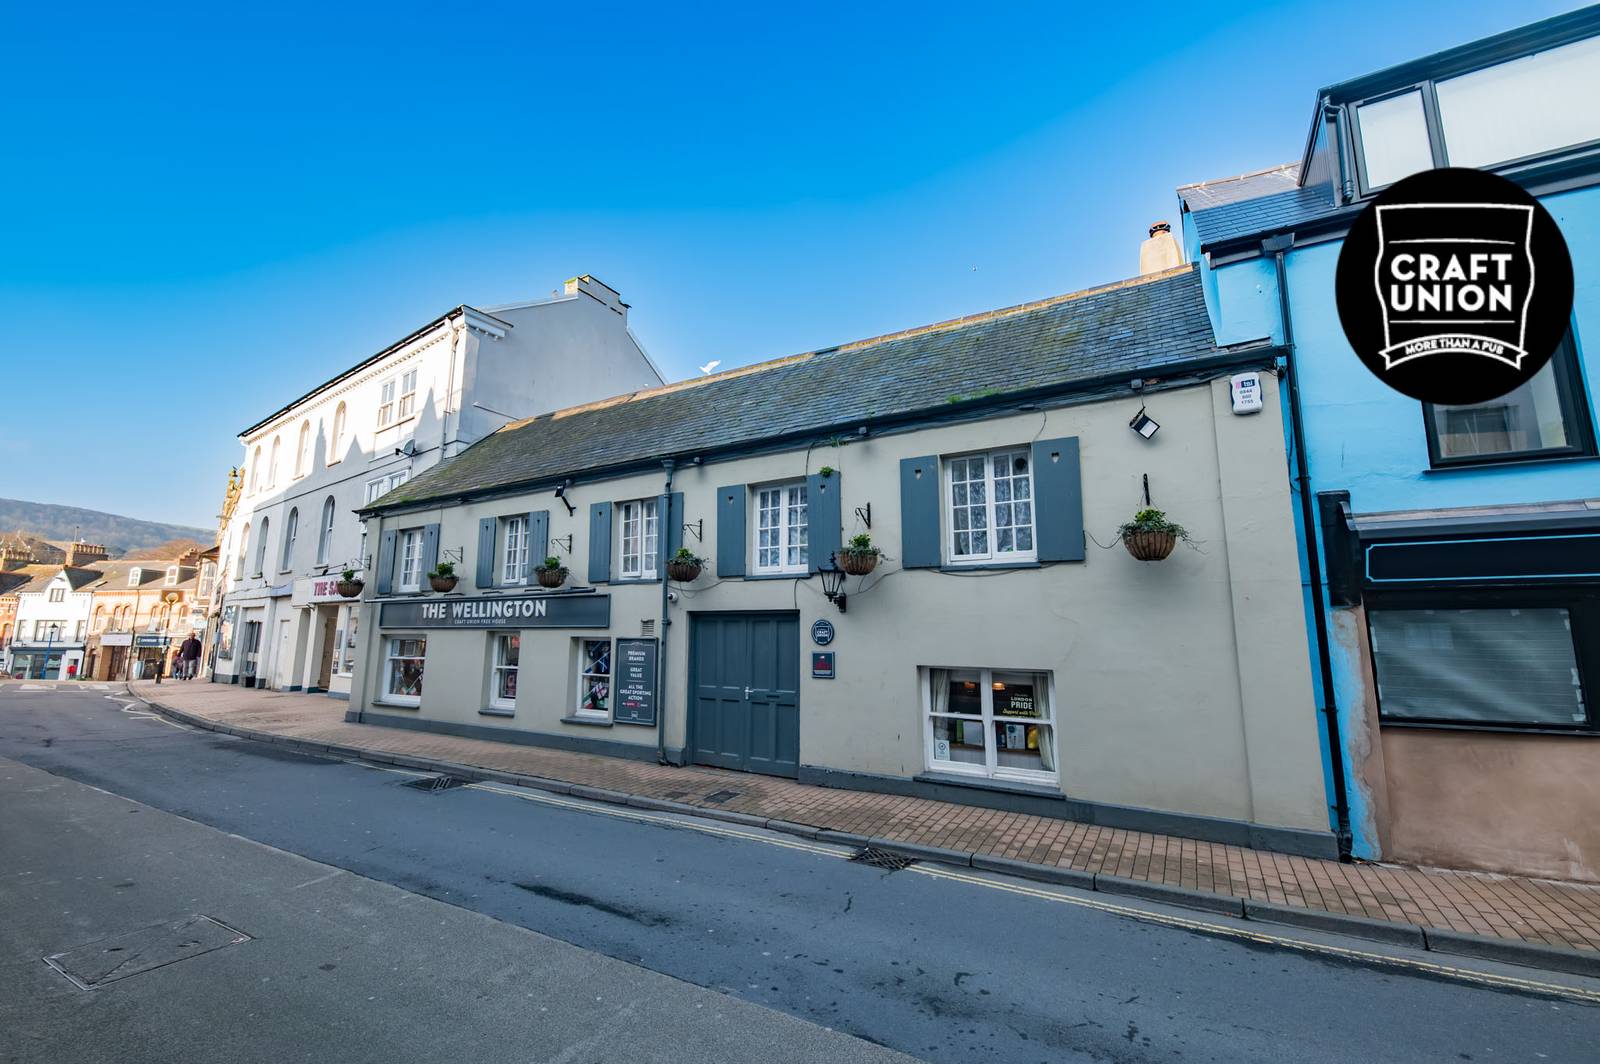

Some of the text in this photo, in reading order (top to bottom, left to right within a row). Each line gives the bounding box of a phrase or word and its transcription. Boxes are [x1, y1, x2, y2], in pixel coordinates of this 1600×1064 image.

[314, 582, 328, 596] THE
[422, 600, 546, 619] THE WELLINGTON
[1010, 701, 1033, 709] PRIDE
